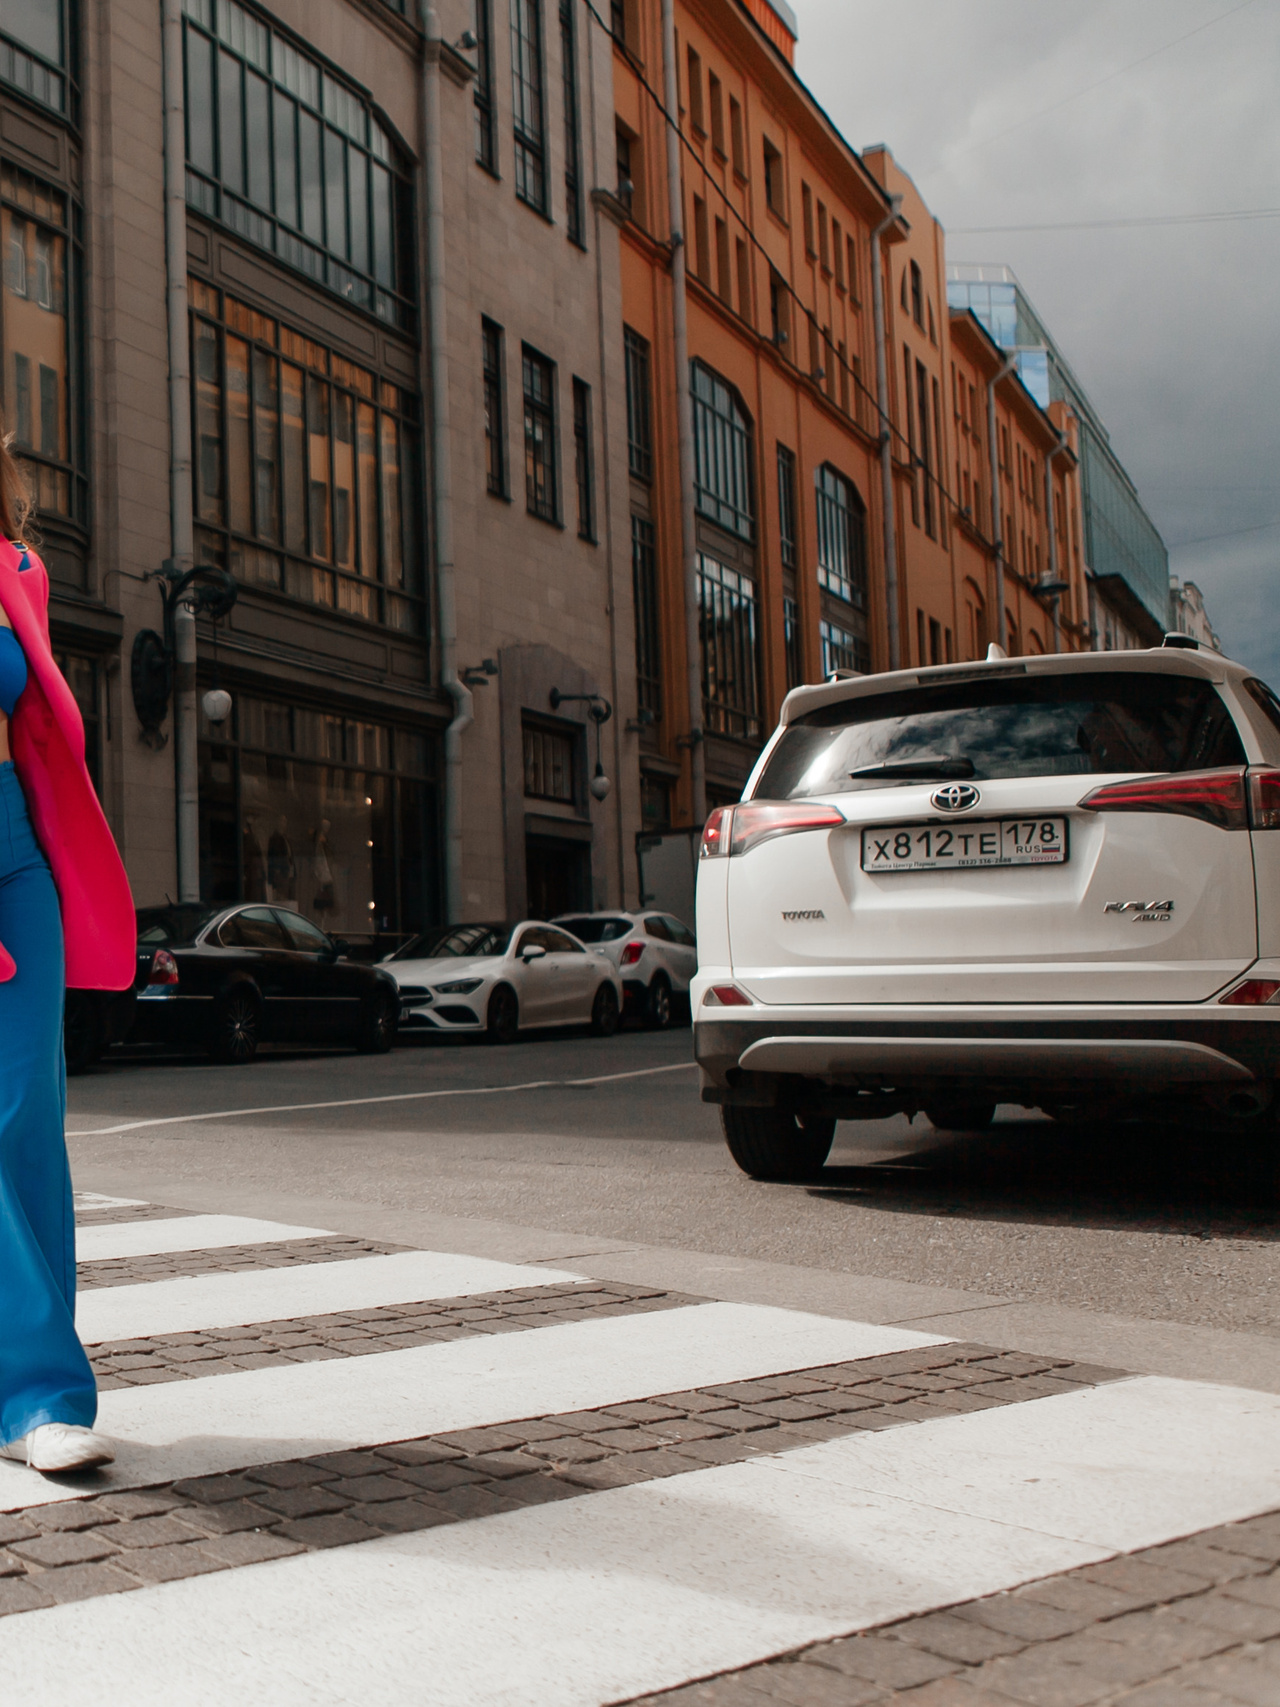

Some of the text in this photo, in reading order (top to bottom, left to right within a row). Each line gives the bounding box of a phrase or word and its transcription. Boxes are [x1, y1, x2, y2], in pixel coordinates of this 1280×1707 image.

[1006, 822, 1055, 845] 178
[1016, 845, 1041, 854] RUS
[1103, 900, 1174, 913] RAV4
[781, 909, 825, 920] TOYOTA
[1132, 914, 1171, 922] AWD
